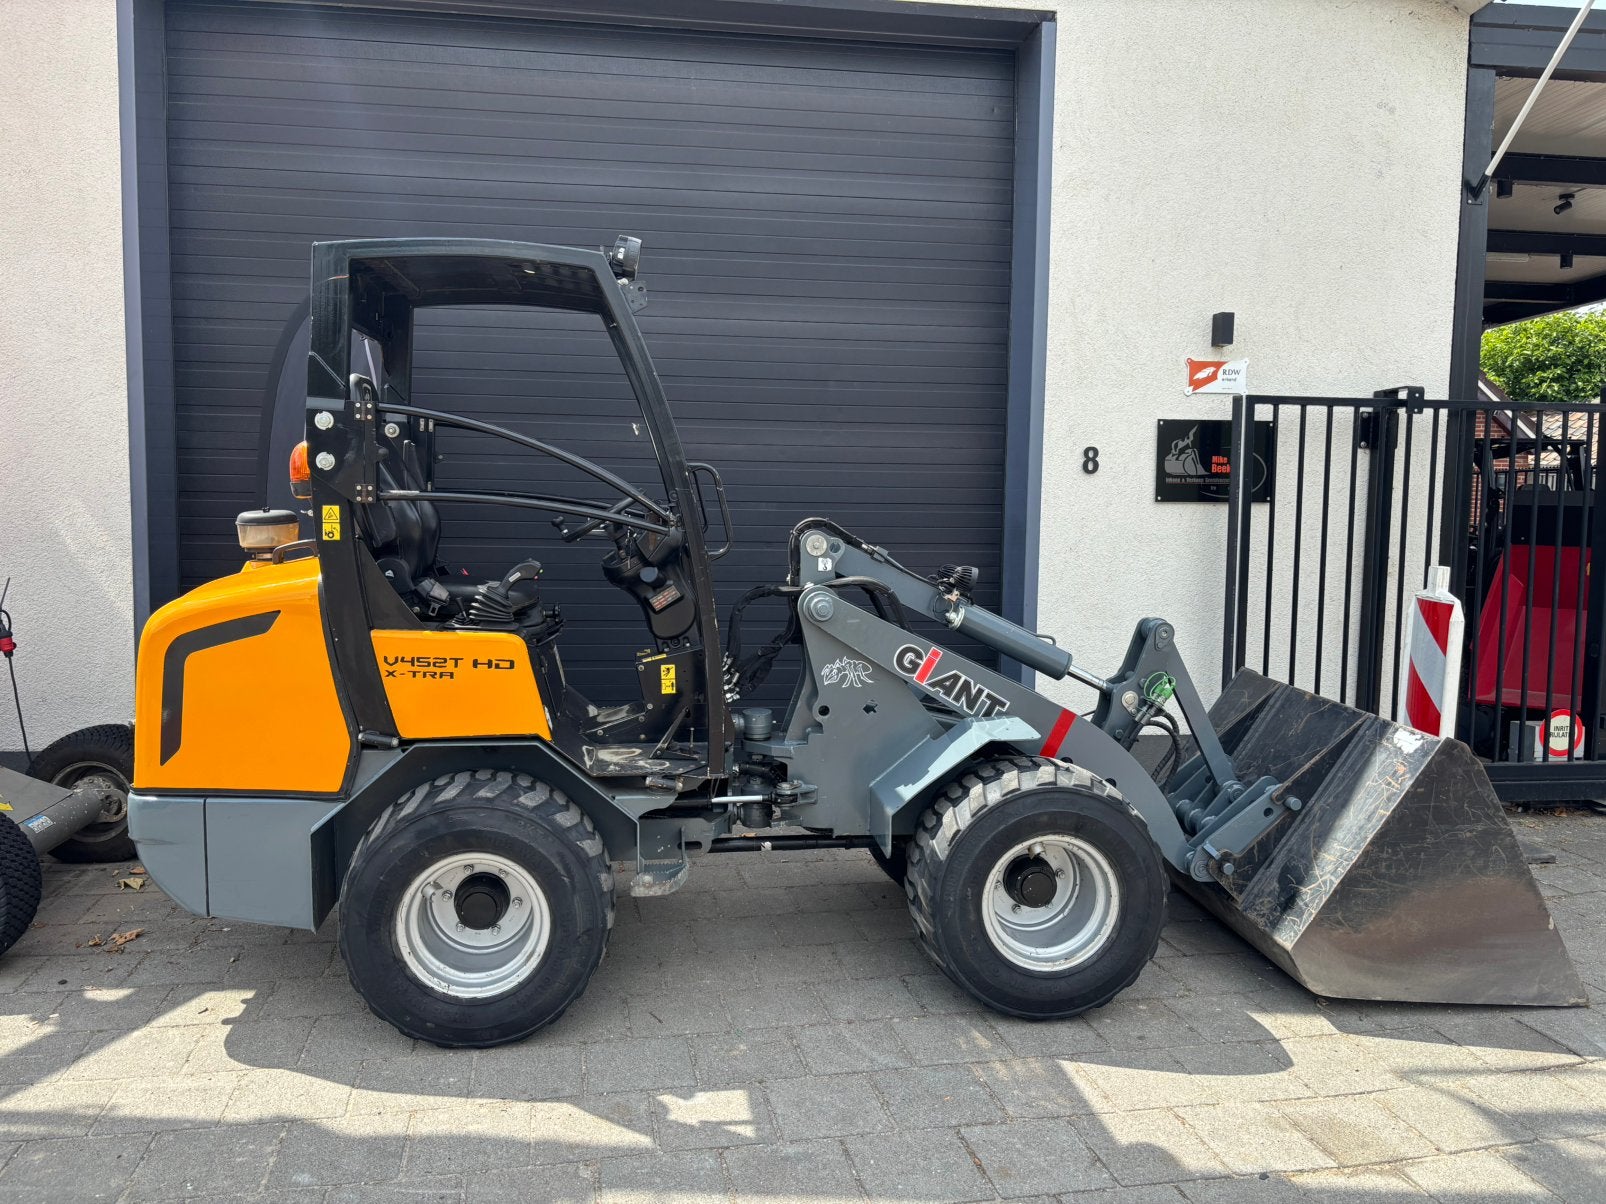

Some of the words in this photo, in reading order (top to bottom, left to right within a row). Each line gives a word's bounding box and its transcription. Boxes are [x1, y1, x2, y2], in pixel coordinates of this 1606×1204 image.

[1222, 368, 1242, 376] RDW
[1082, 446, 1100, 475] 8
[1211, 455, 1228, 464] Mike
[383, 655, 464, 669] V452T
[472, 658, 515, 670] HD
[384, 669, 455, 680] X-TRA
